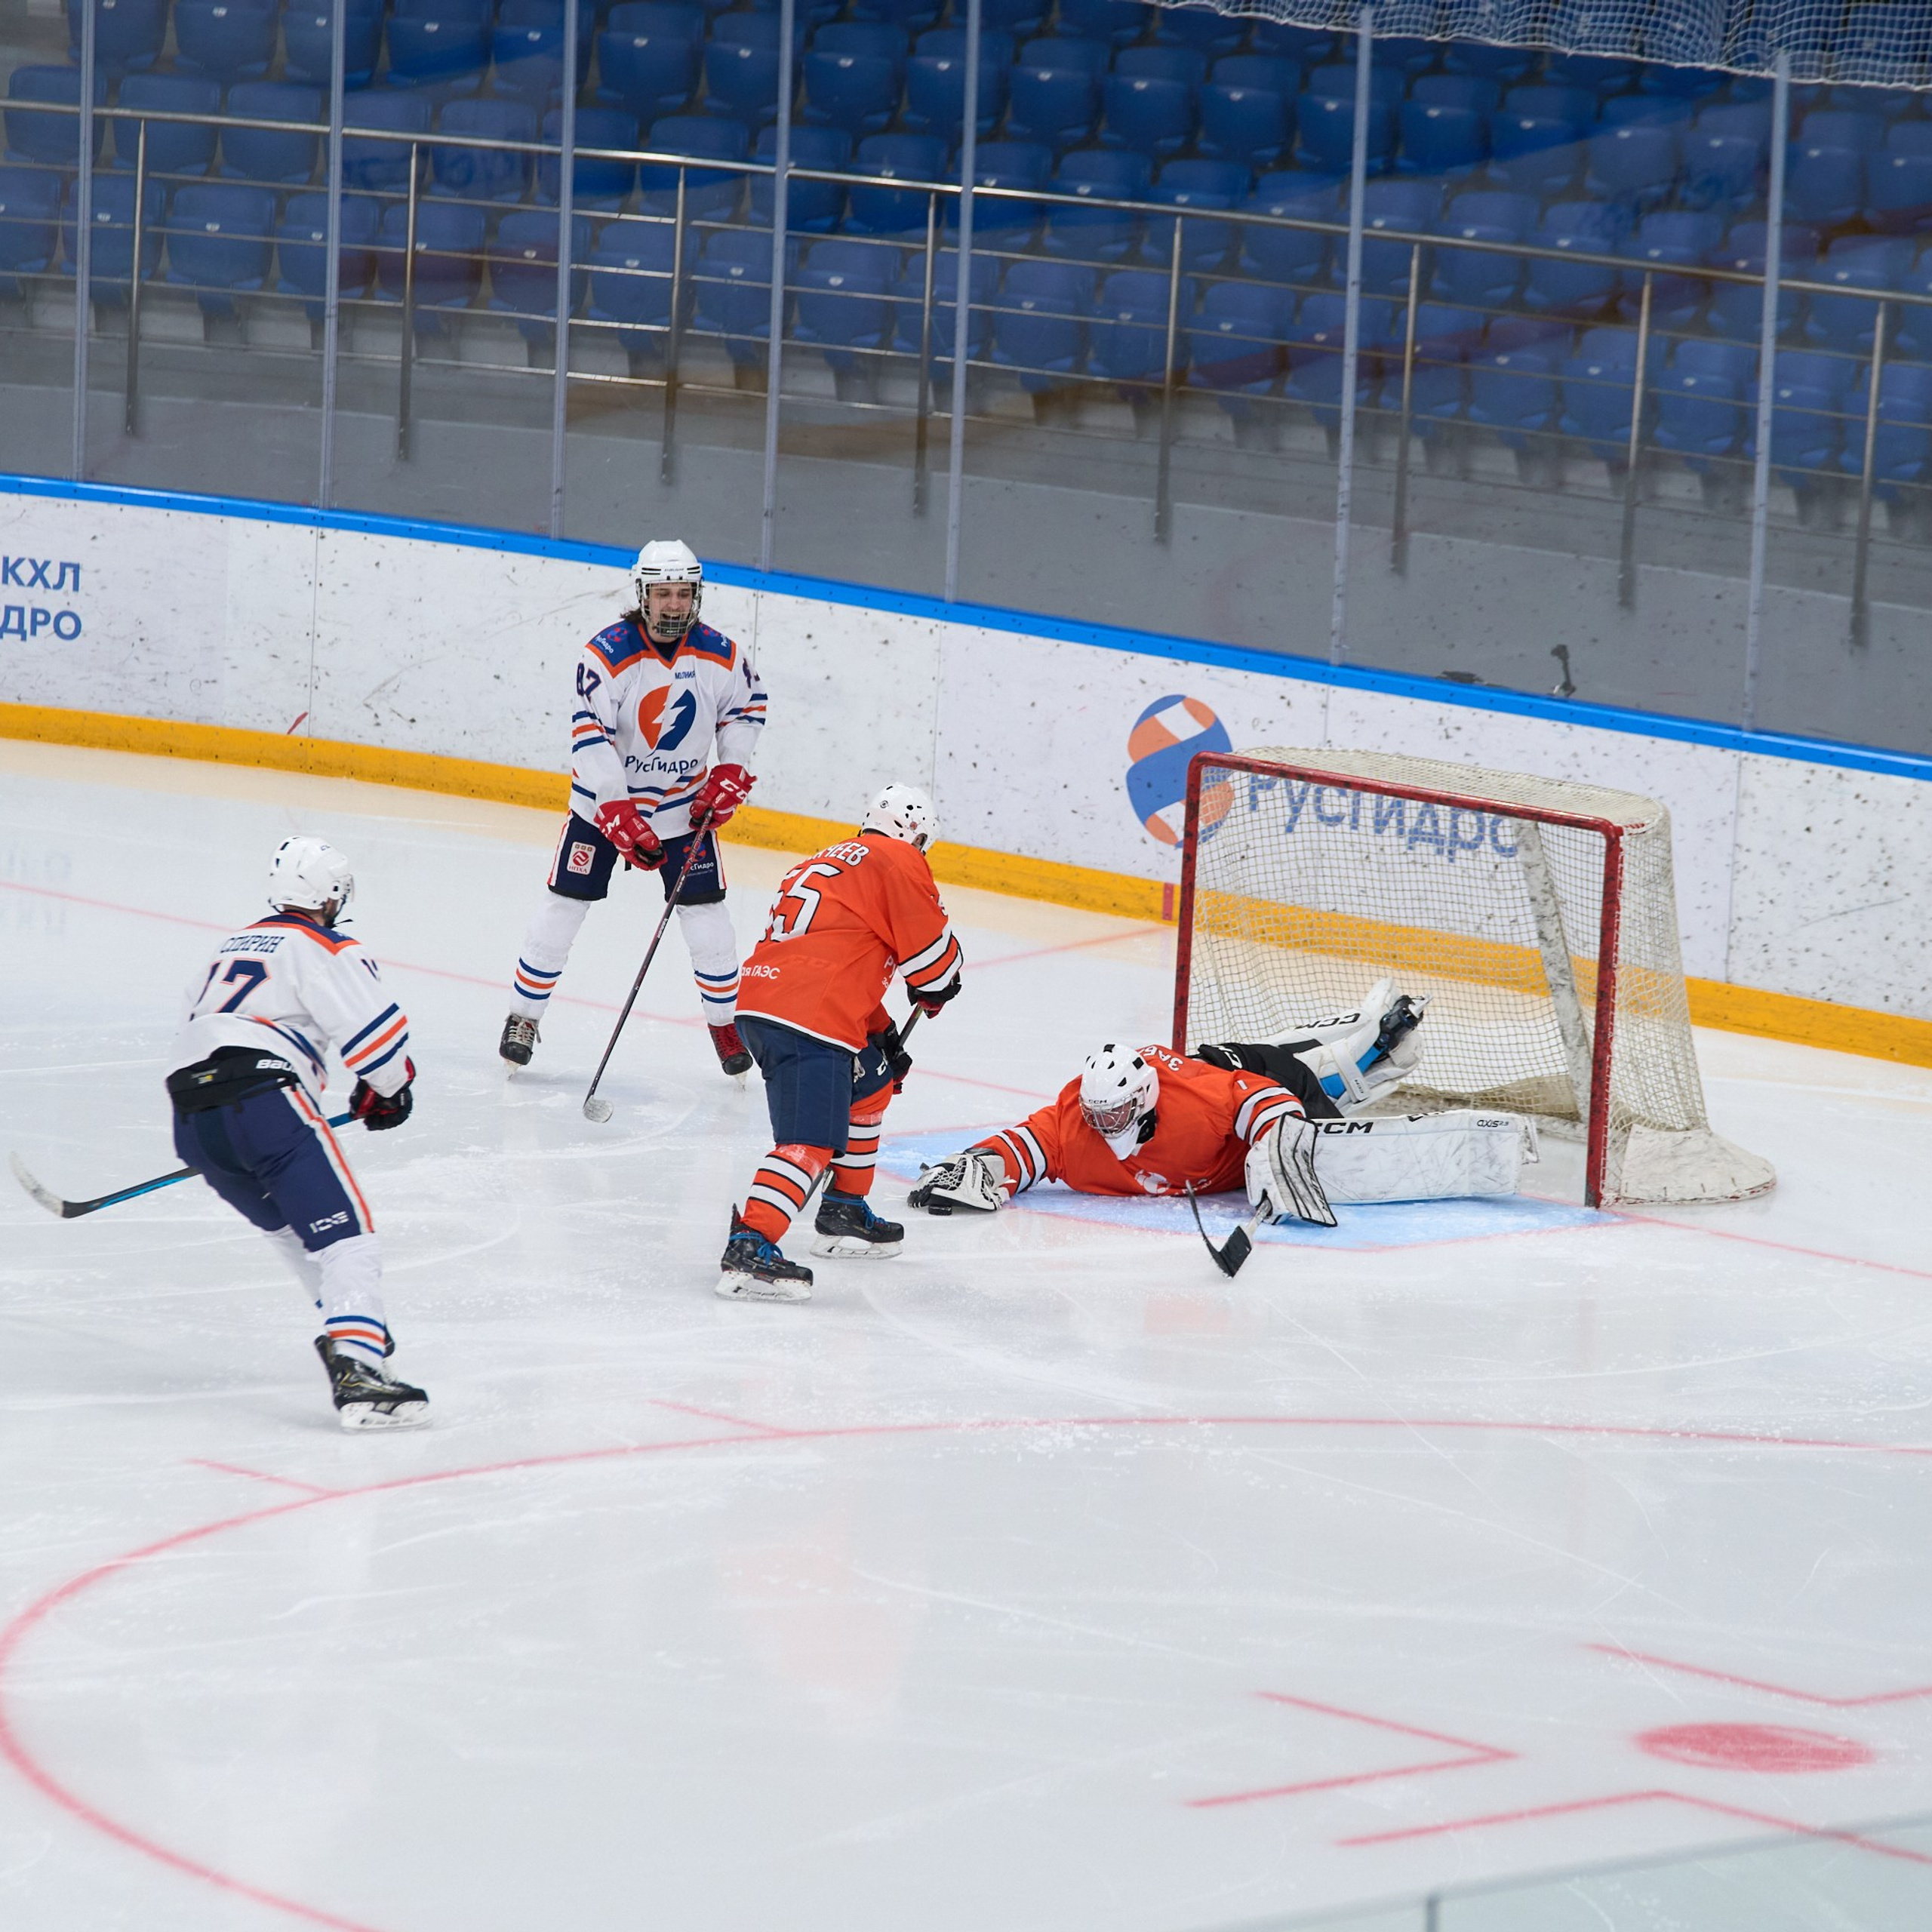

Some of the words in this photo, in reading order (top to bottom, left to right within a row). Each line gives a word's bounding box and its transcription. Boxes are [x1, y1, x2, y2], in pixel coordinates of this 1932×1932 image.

[2, 555, 81, 592] КХЛ
[0, 605, 82, 641] ДРО
[625, 755, 699, 775] РусГидро
[220, 935, 286, 954] СПИРИН
[752, 964, 780, 980] ГАЭС
